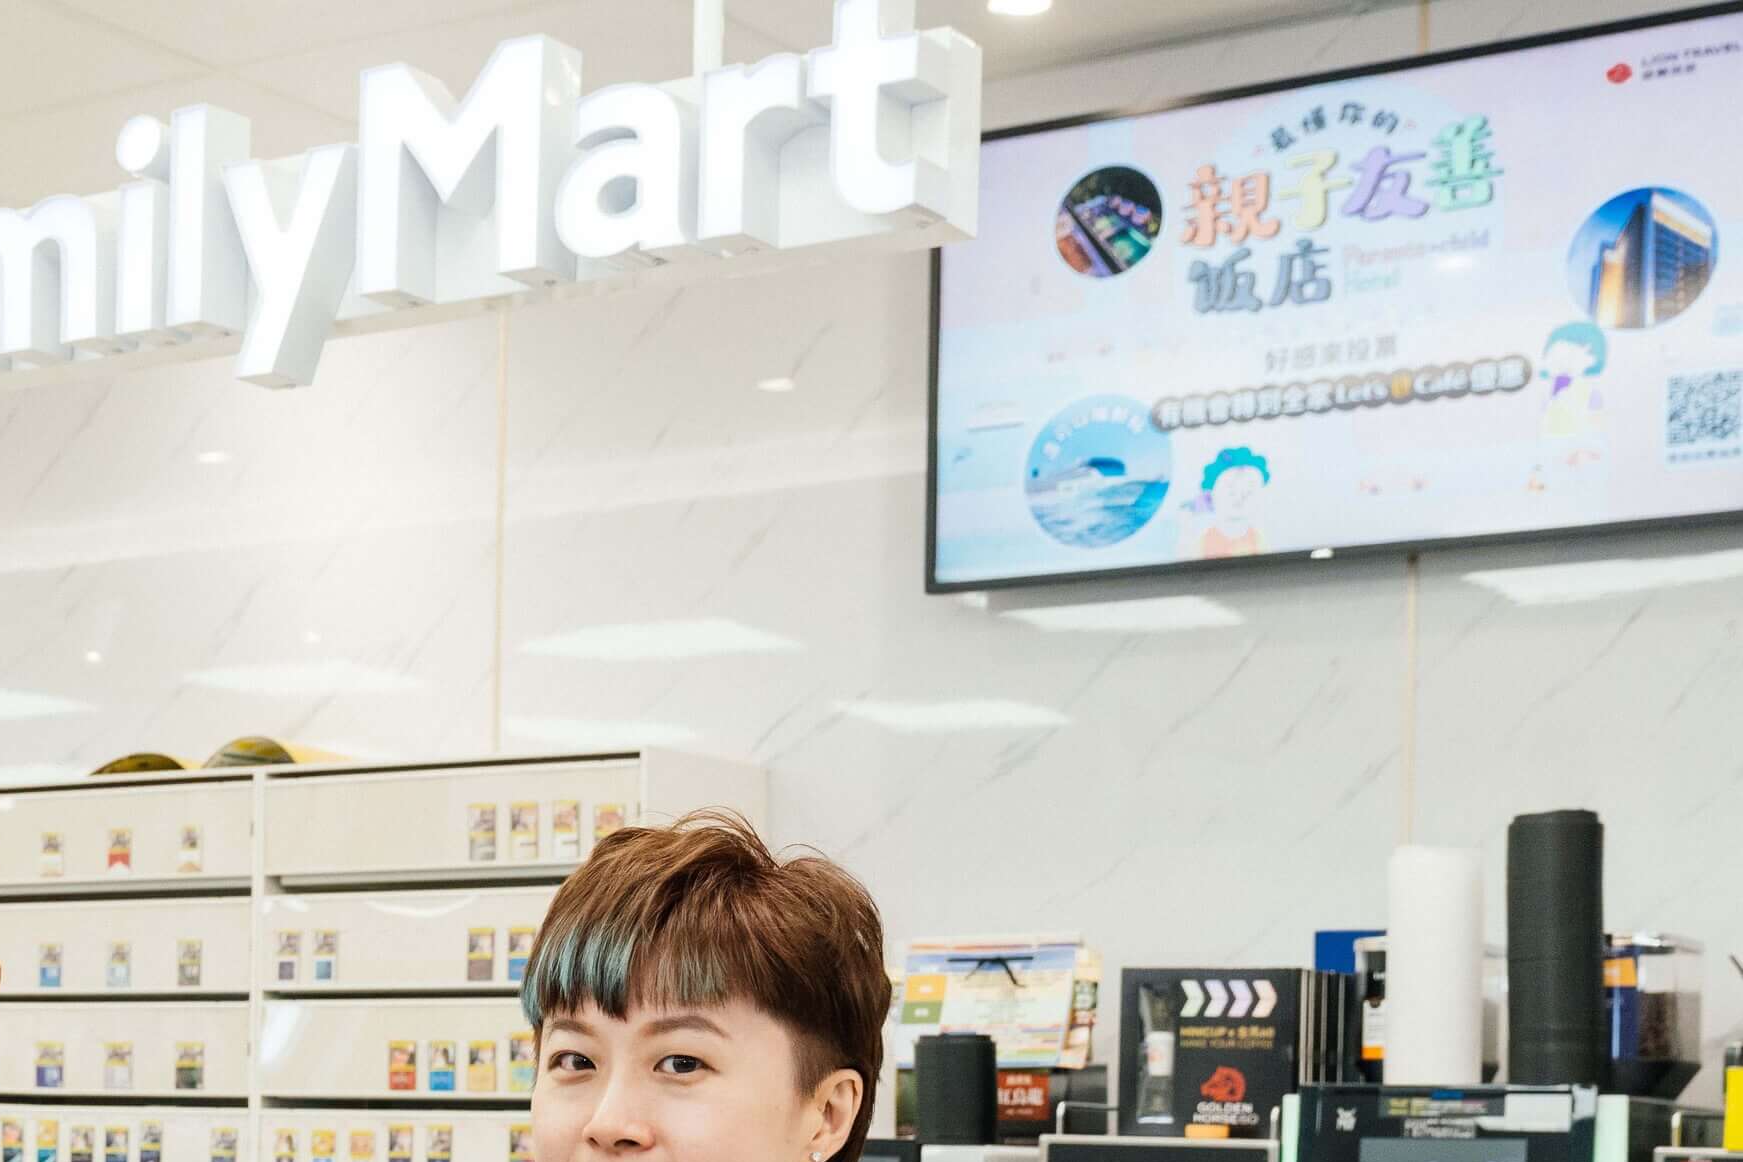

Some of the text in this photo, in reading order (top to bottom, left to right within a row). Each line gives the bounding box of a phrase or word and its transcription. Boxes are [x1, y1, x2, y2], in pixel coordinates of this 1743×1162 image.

[1179, 113, 1504, 247] 親子友善
[1187, 238, 1333, 313] 飯店
